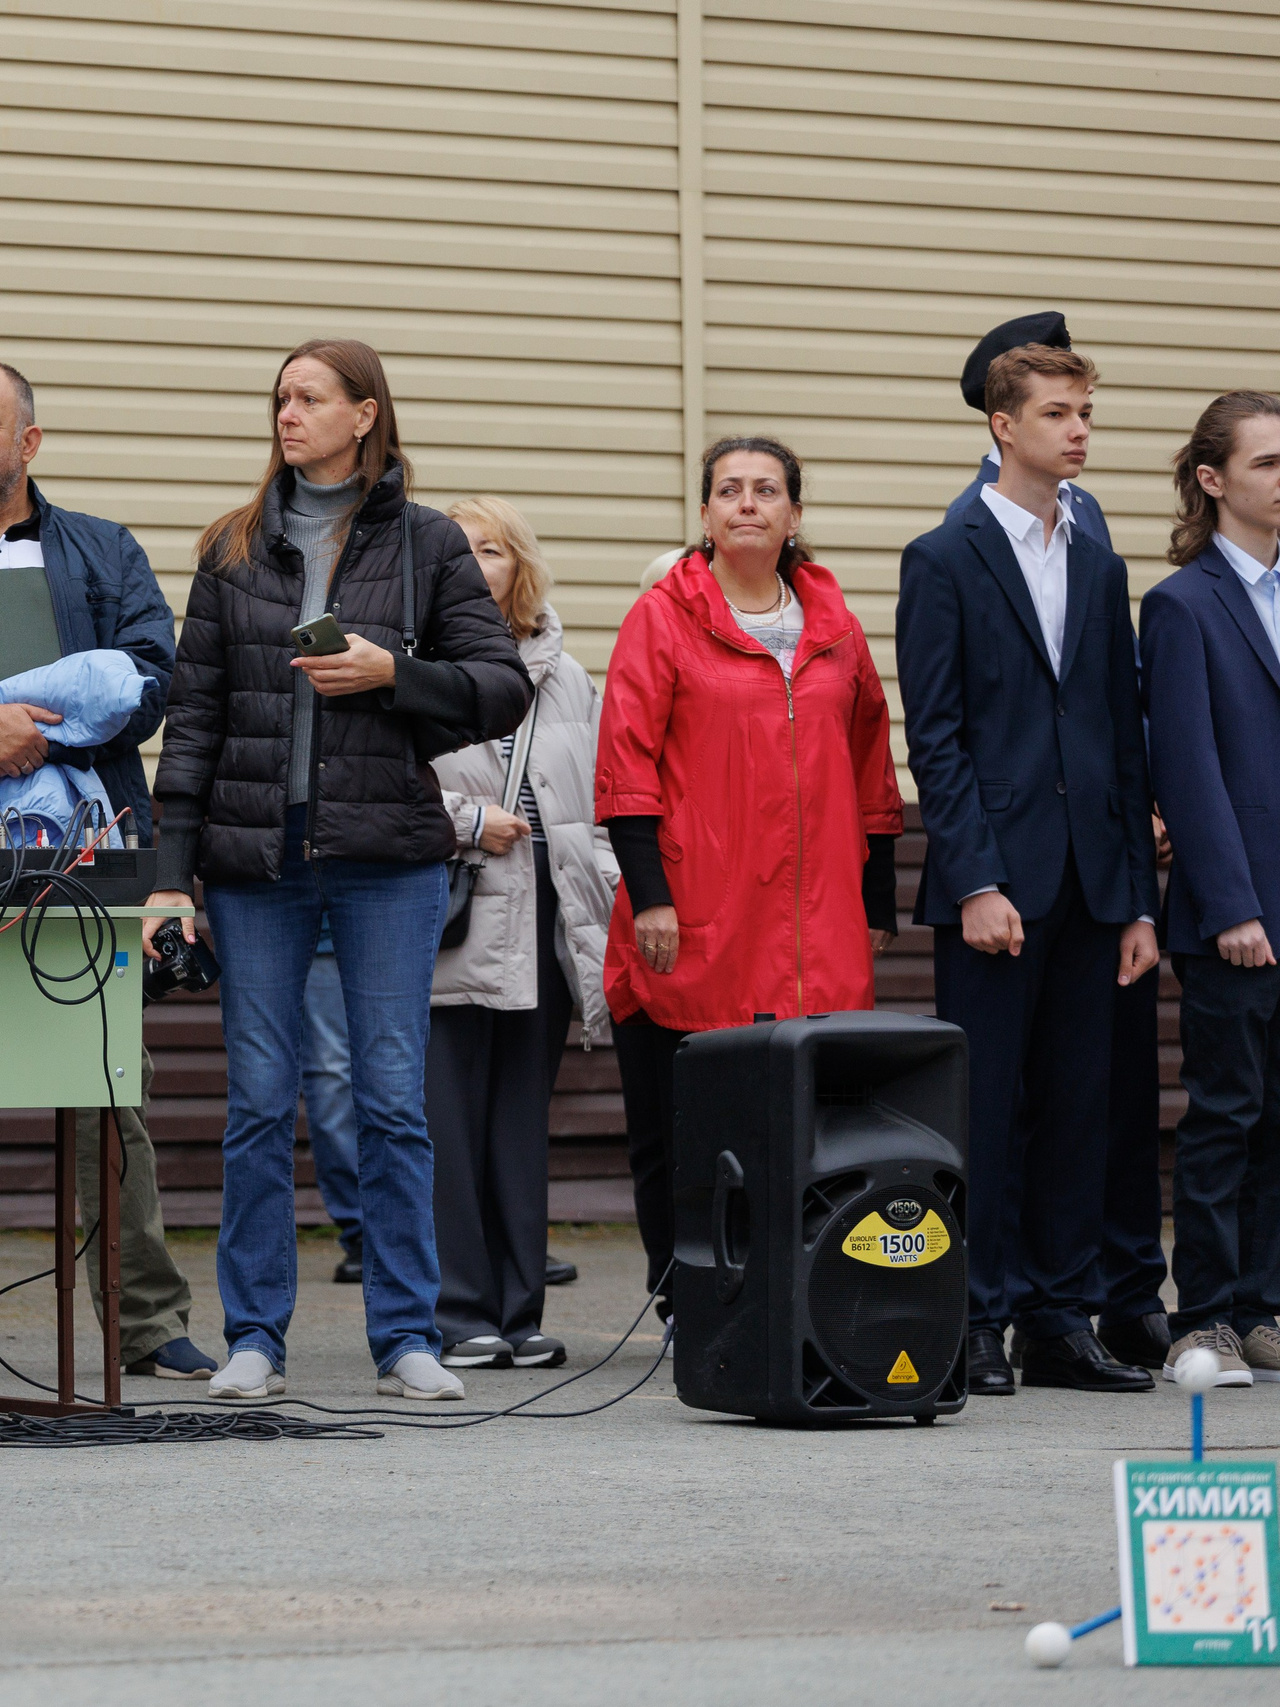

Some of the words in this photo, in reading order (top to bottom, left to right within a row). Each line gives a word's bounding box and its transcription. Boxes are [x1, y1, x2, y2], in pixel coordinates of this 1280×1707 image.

[893, 1201, 917, 1213] 1500
[849, 1235, 877, 1243] EUROLIVE
[879, 1233, 926, 1254] 1500
[889, 1254, 918, 1263] WATTS
[1132, 1485, 1274, 1518] ХИМИЯ
[1245, 1616, 1279, 1654] 11
